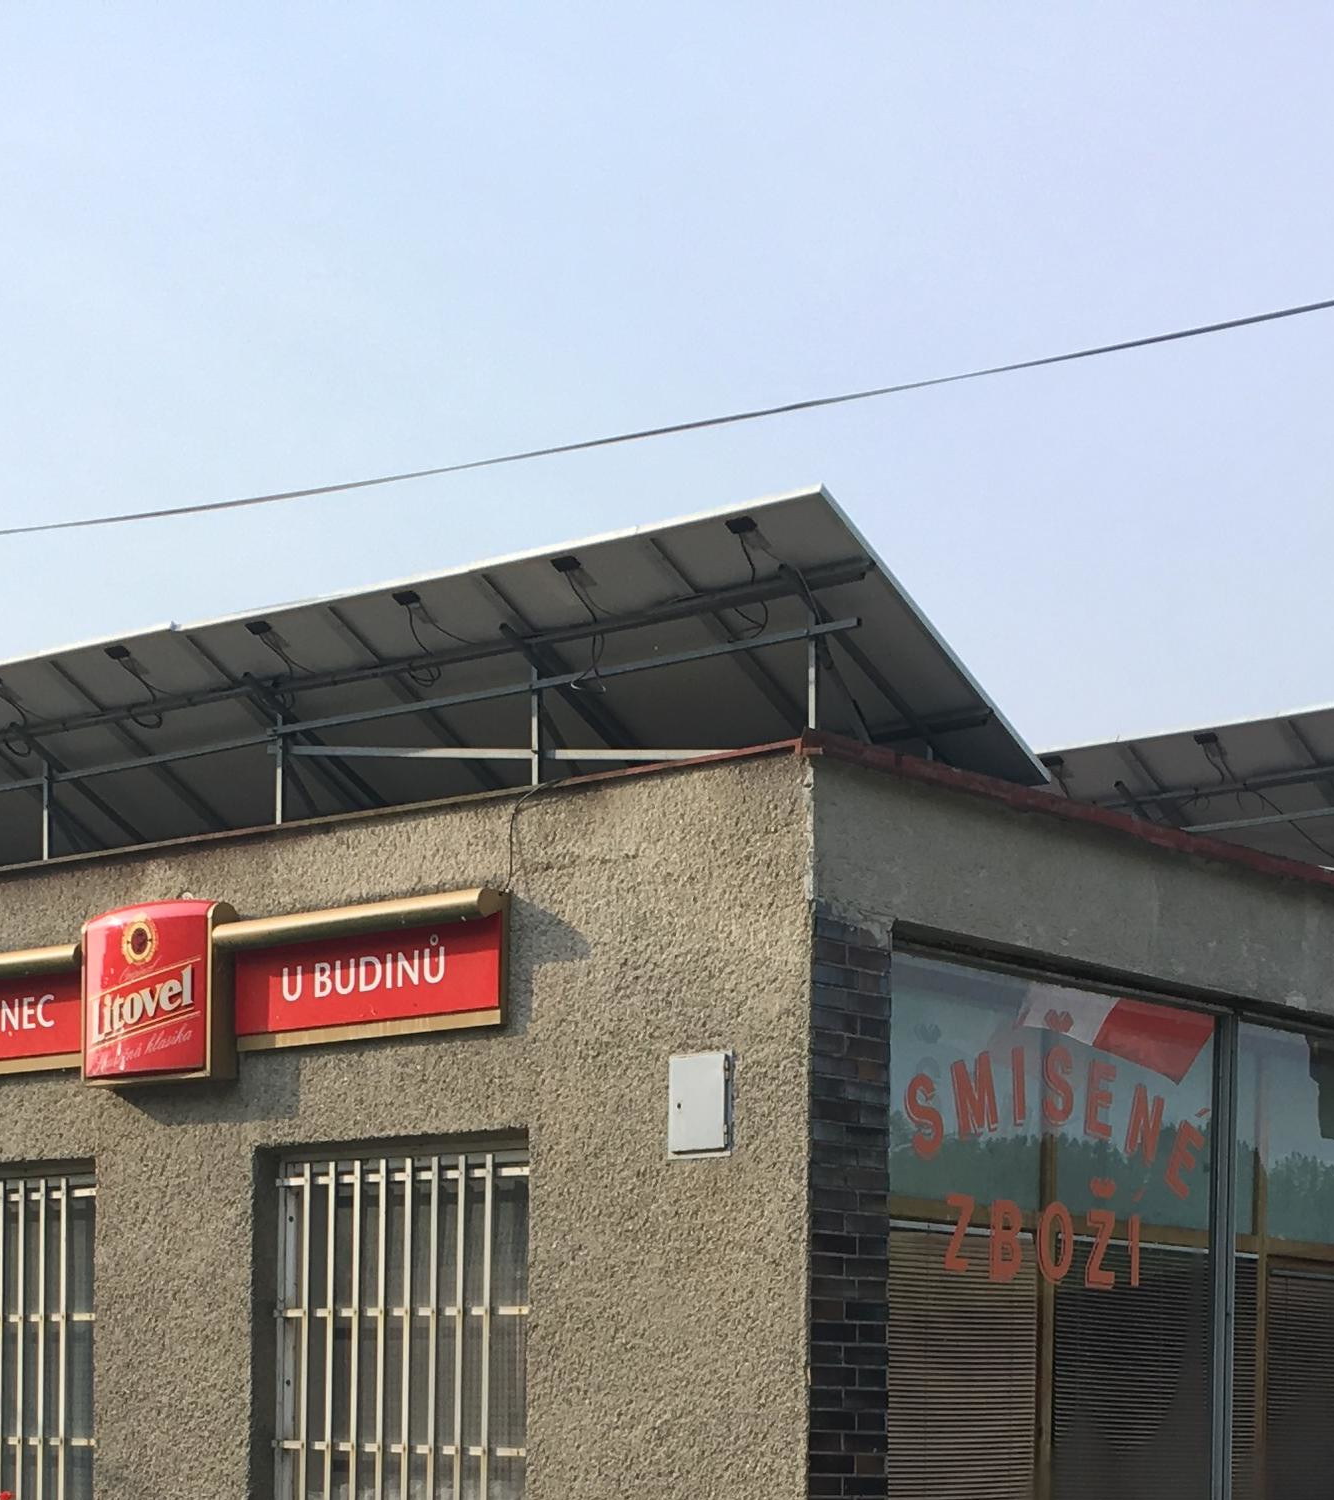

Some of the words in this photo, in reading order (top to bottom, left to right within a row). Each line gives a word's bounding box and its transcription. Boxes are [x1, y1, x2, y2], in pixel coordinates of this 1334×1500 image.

[91, 964, 195, 1044] Litovel
[282, 965, 303, 1002] U
[314, 934, 446, 998] BUDINŮ
[944, 1178, 1141, 1289] ZBOŽÍ
